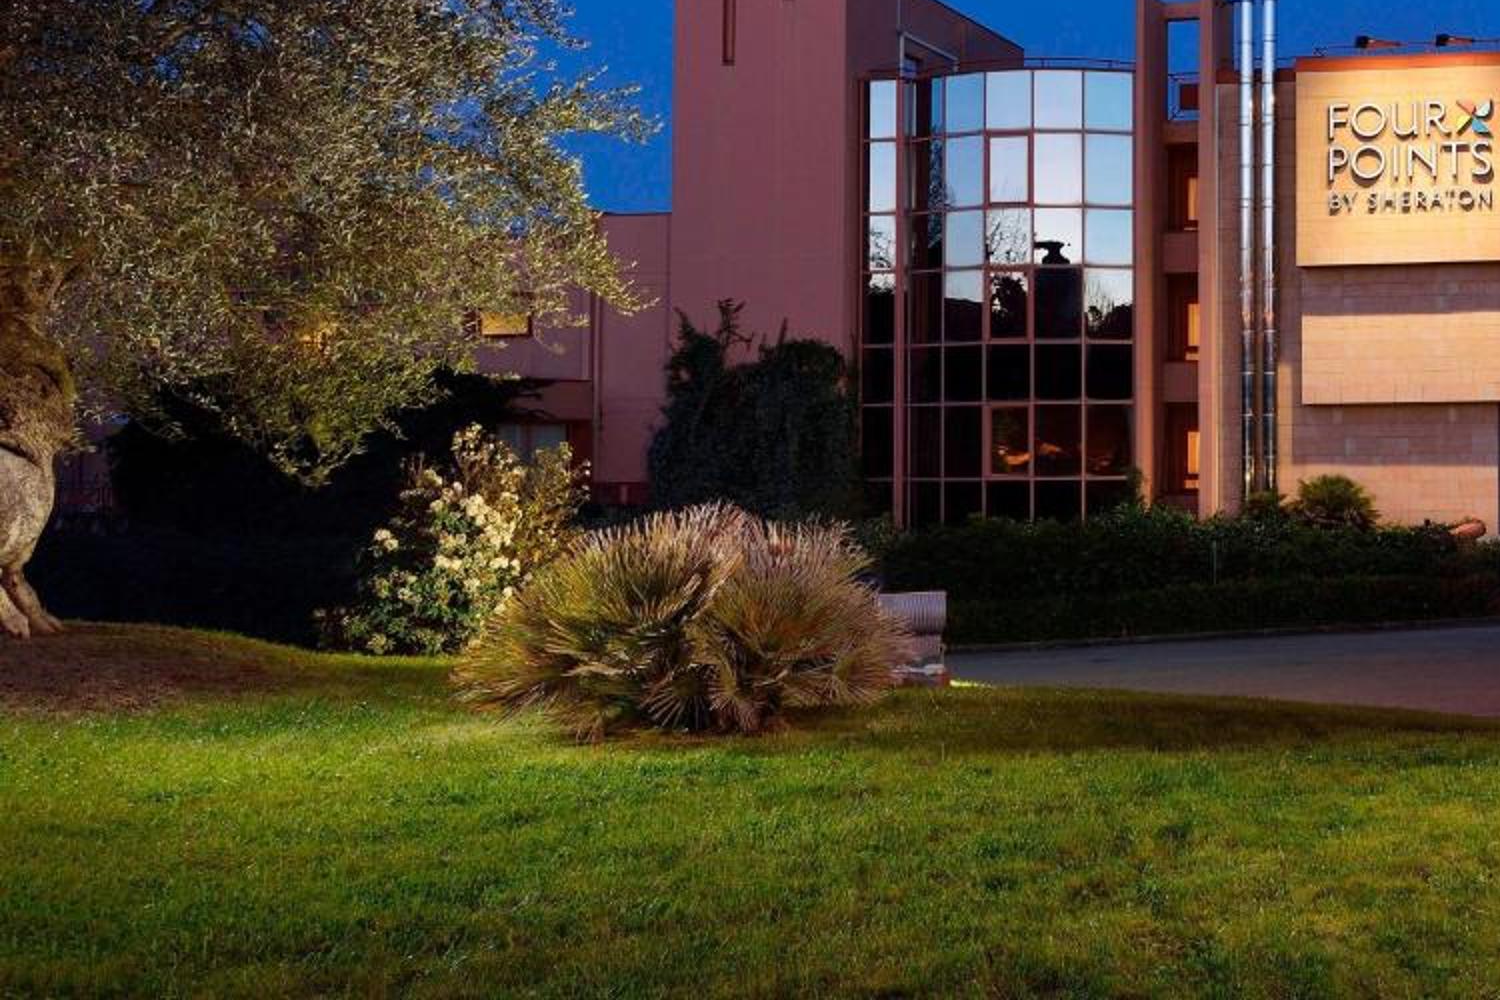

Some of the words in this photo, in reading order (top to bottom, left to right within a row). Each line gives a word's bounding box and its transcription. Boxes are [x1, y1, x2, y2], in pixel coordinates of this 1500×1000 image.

[1327, 101, 1452, 139] FOUR
[1327, 141, 1494, 182] POINTS
[1328, 192, 1358, 214] BY
[1367, 190, 1494, 214] SHERATON
